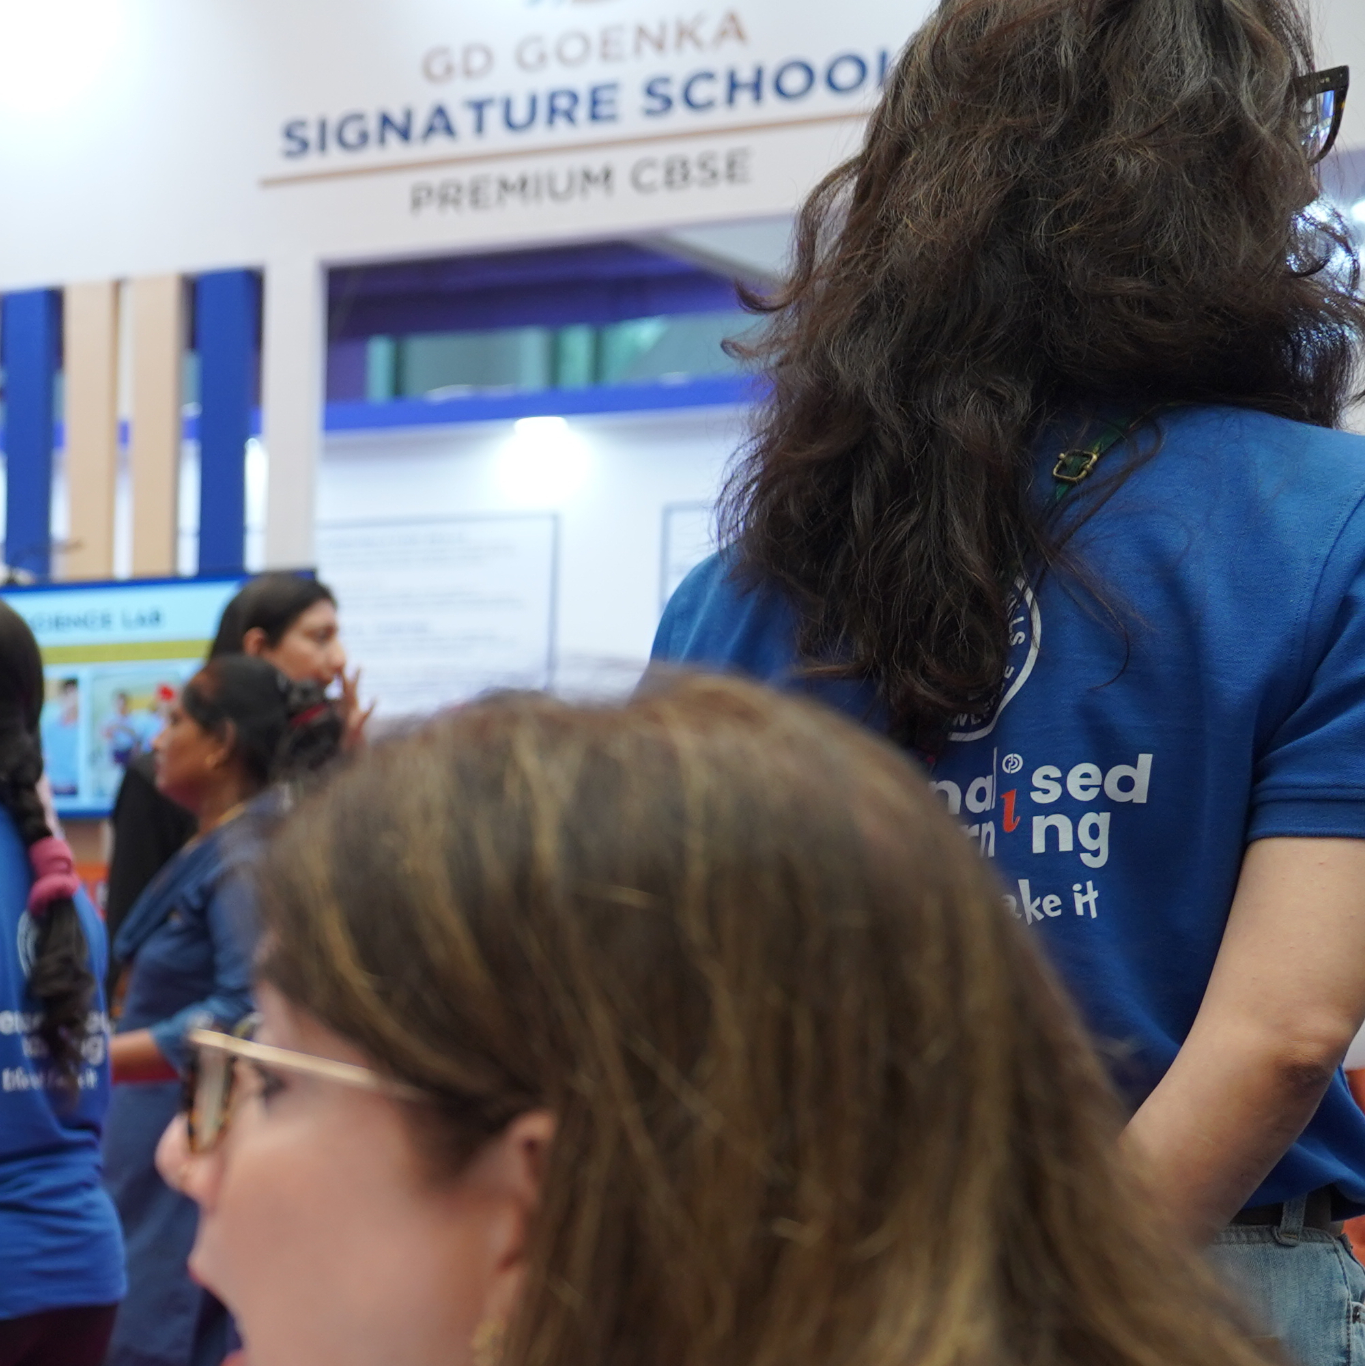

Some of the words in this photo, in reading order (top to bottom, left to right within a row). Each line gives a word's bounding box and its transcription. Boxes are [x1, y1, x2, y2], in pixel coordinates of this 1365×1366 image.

[422, 45, 494, 84] GD
[516, 11, 749, 71] GOENKA
[283, 83, 618, 159] SIGNATURE
[411, 161, 612, 216] PREMIUM
[631, 147, 752, 195] CBSE
[1072, 880, 1099, 919] it
